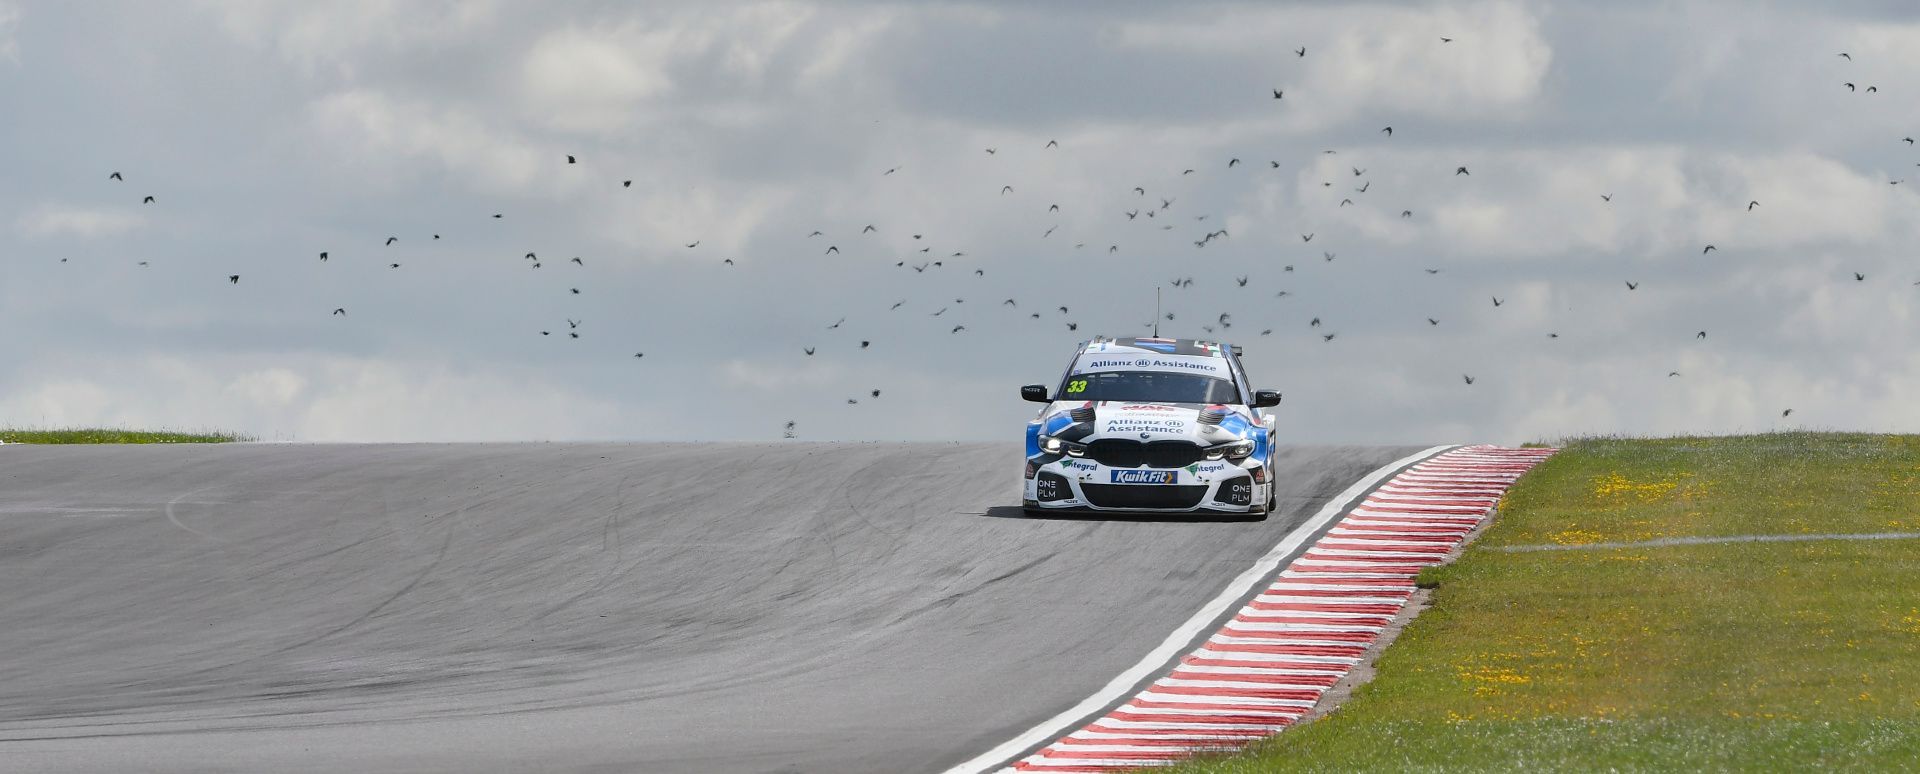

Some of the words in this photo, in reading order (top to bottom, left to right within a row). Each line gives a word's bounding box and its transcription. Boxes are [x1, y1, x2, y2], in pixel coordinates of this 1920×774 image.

[1090, 360, 1132, 368] Allianz
[1153, 360, 1217, 371] Assistance
[1067, 380, 1087, 393] 33
[1107, 425, 1184, 434] Assistance
[1038, 480, 1056, 488] ONE
[1232, 484, 1250, 493] ONE
[1038, 489, 1056, 498] PLM
[1231, 494, 1250, 502] PLM
